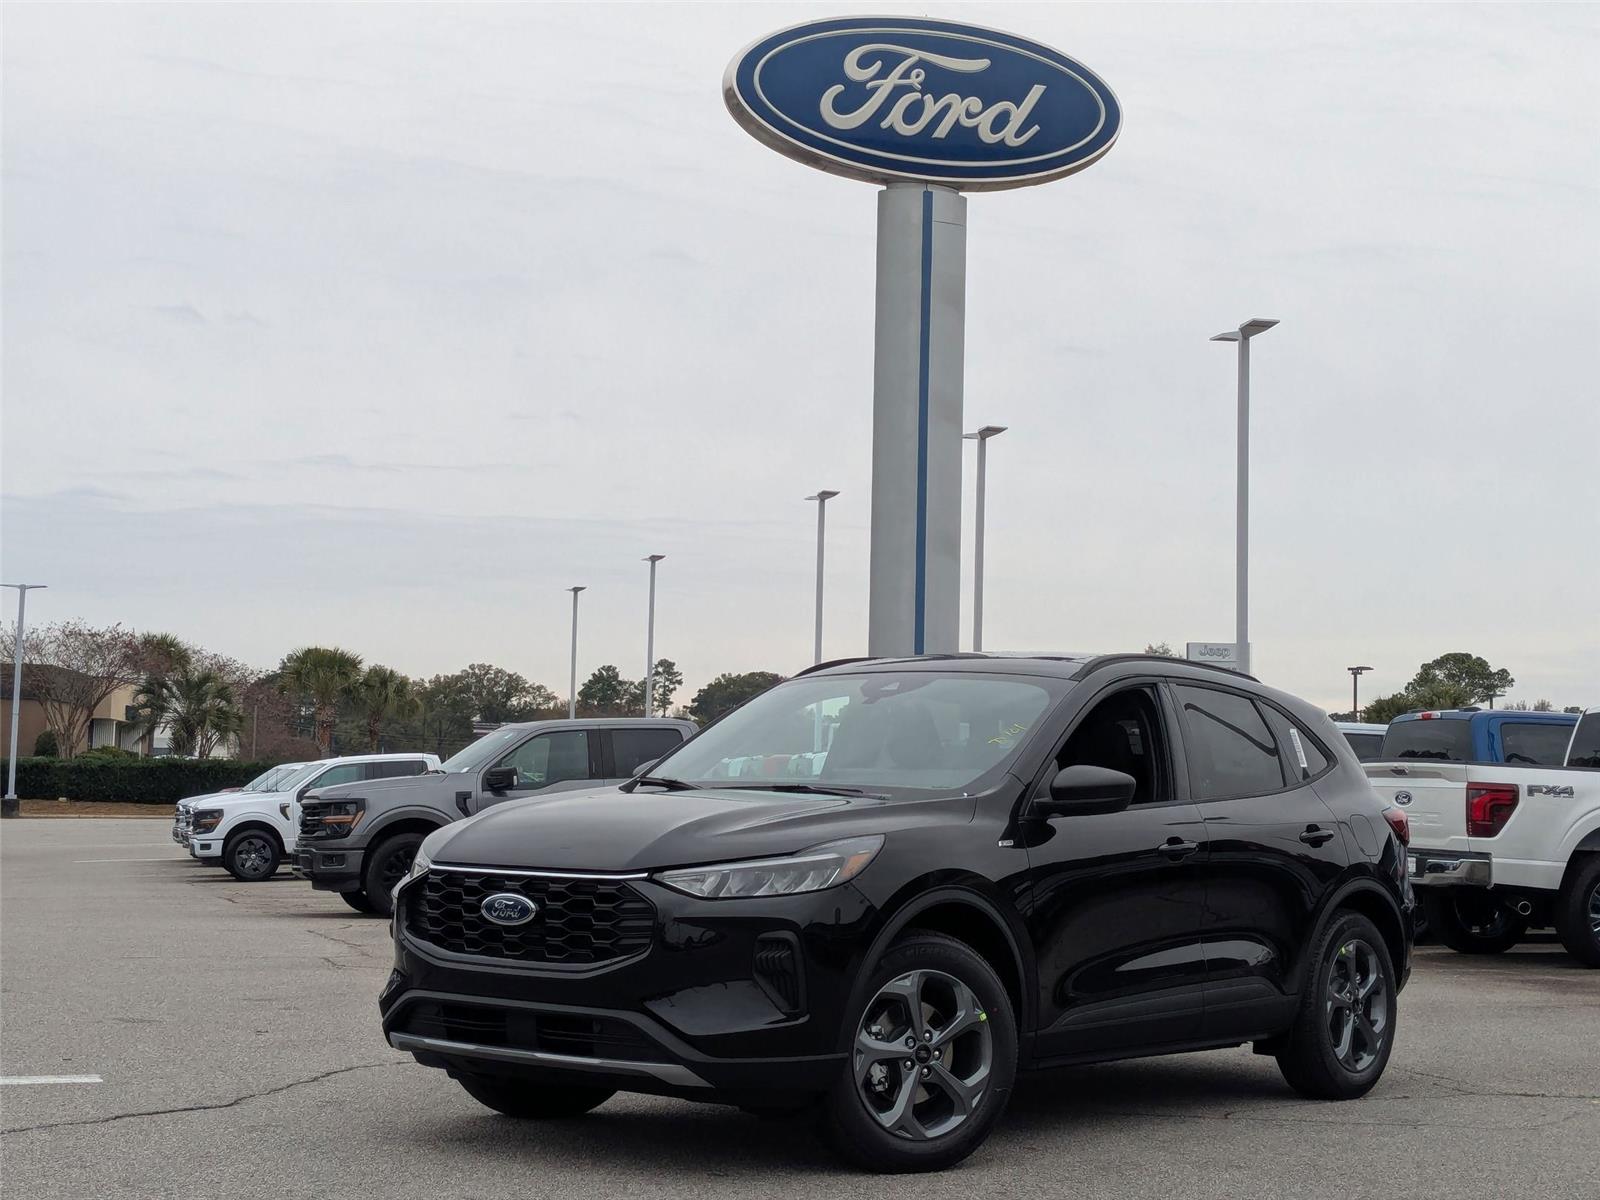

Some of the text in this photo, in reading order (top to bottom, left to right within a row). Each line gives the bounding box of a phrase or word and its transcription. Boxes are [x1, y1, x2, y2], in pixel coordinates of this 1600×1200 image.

[819, 43, 1048, 147] Ford
[1199, 645, 1231, 659] Jeep
[1527, 784, 1575, 798] FX4
[491, 899, 521, 918] Ford
